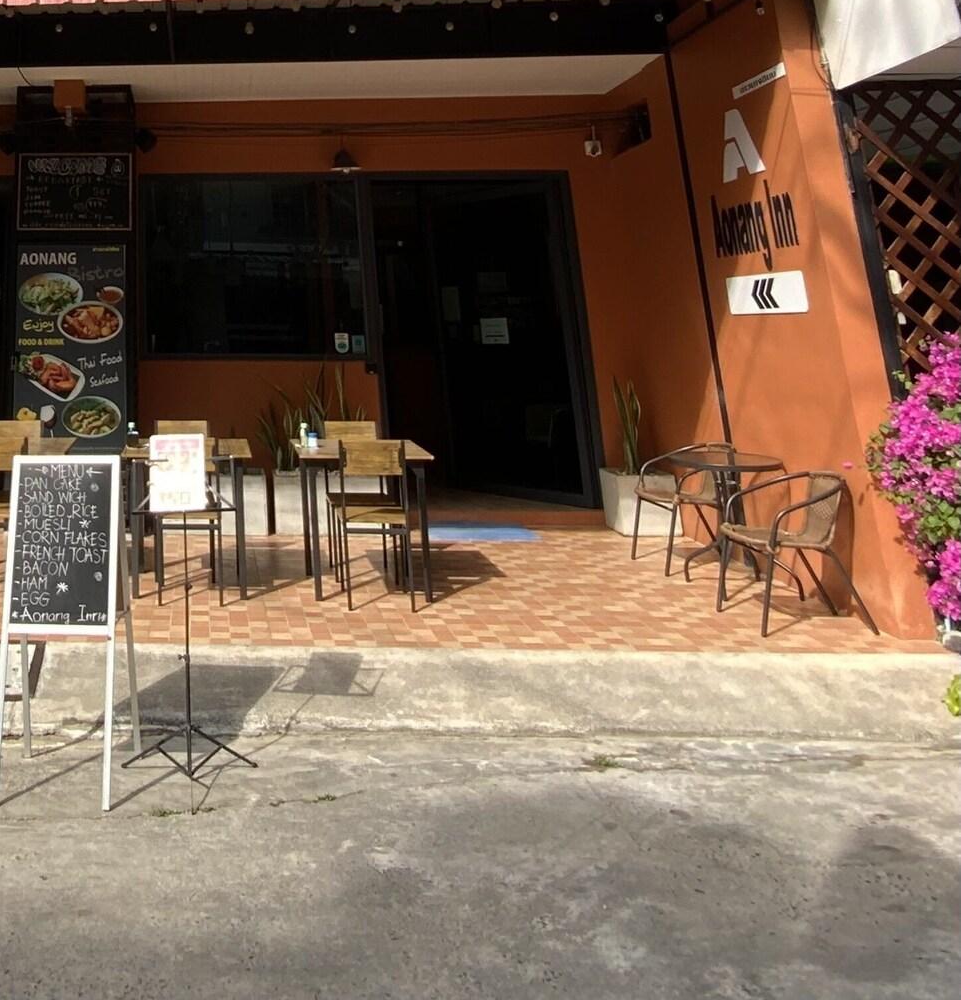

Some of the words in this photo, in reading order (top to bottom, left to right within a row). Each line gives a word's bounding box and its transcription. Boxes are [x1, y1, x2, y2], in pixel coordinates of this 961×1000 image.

[710, 194, 773, 272] Aonang
[762, 178, 800, 249] Inn
[19, 252, 77, 265] AONANG
[66, 265, 125, 282] Bistro
[22, 319, 55, 333] Enjoy
[18, 338, 37, 346] FOOD
[44, 338, 64, 346] DRINK
[77, 355, 96, 371] Thai
[99, 350, 123, 367] Food
[89, 371, 120, 388] Seafood
[49, 464, 85, 479] MENU
[24, 477, 48, 491] PAN
[23, 491, 54, 505] SAND
[58, 490, 87, 504] WICH
[24, 504, 66, 518] BOILED
[71, 502, 99, 519] RICE
[24, 515, 71, 531] MUESLI
[22, 530, 60, 545] CORN
[64, 531, 107, 548] FLAKES
[22, 545, 65, 561] FRENCH
[70, 546, 108, 564] TOAST
[22, 560, 69, 576] BACON
[21, 576, 48, 591] HAM
[20, 591, 51, 607] EGG
[20, 606, 70, 624] Aonang
